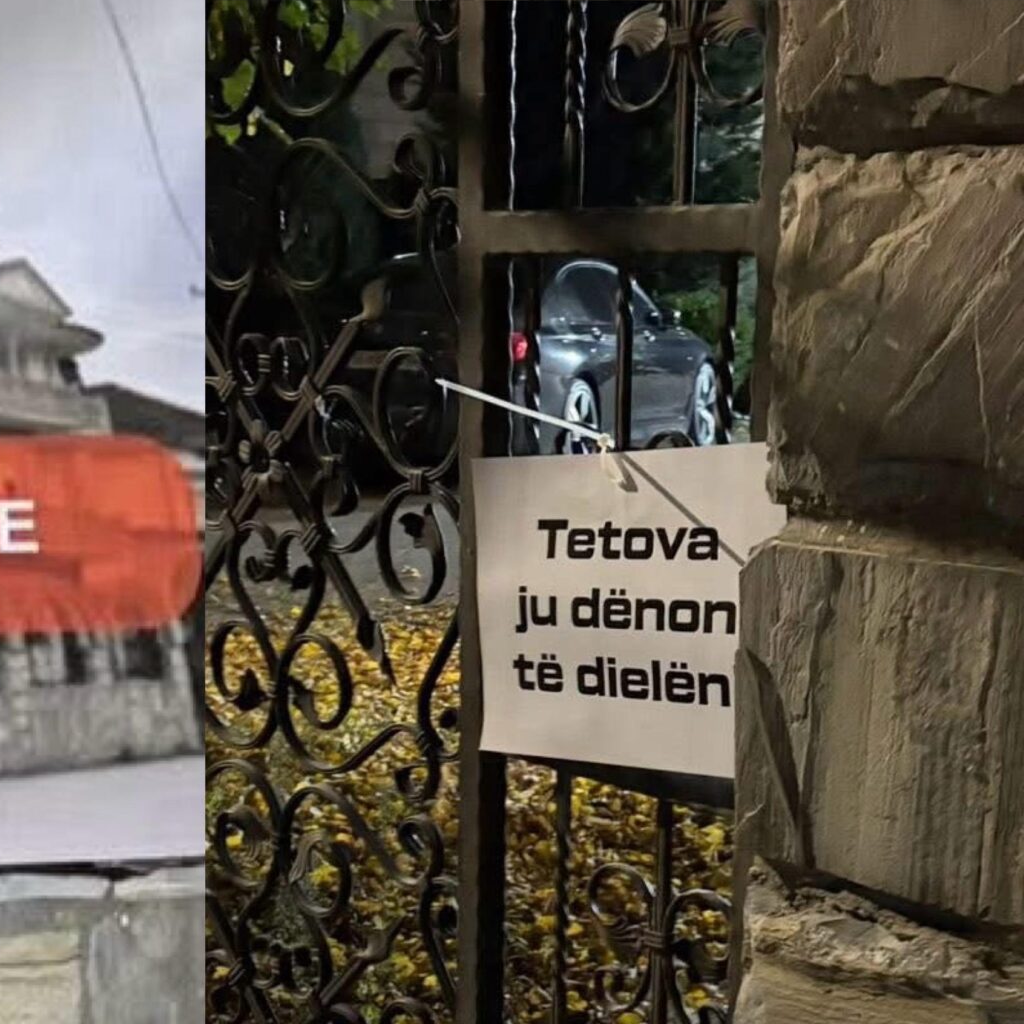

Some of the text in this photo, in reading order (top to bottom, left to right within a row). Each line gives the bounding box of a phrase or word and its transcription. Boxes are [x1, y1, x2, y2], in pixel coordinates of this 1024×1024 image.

[538, 519, 719, 561] Tetova
[515, 586, 737, 635] ju dënon
[513, 653, 731, 707] të dielën
